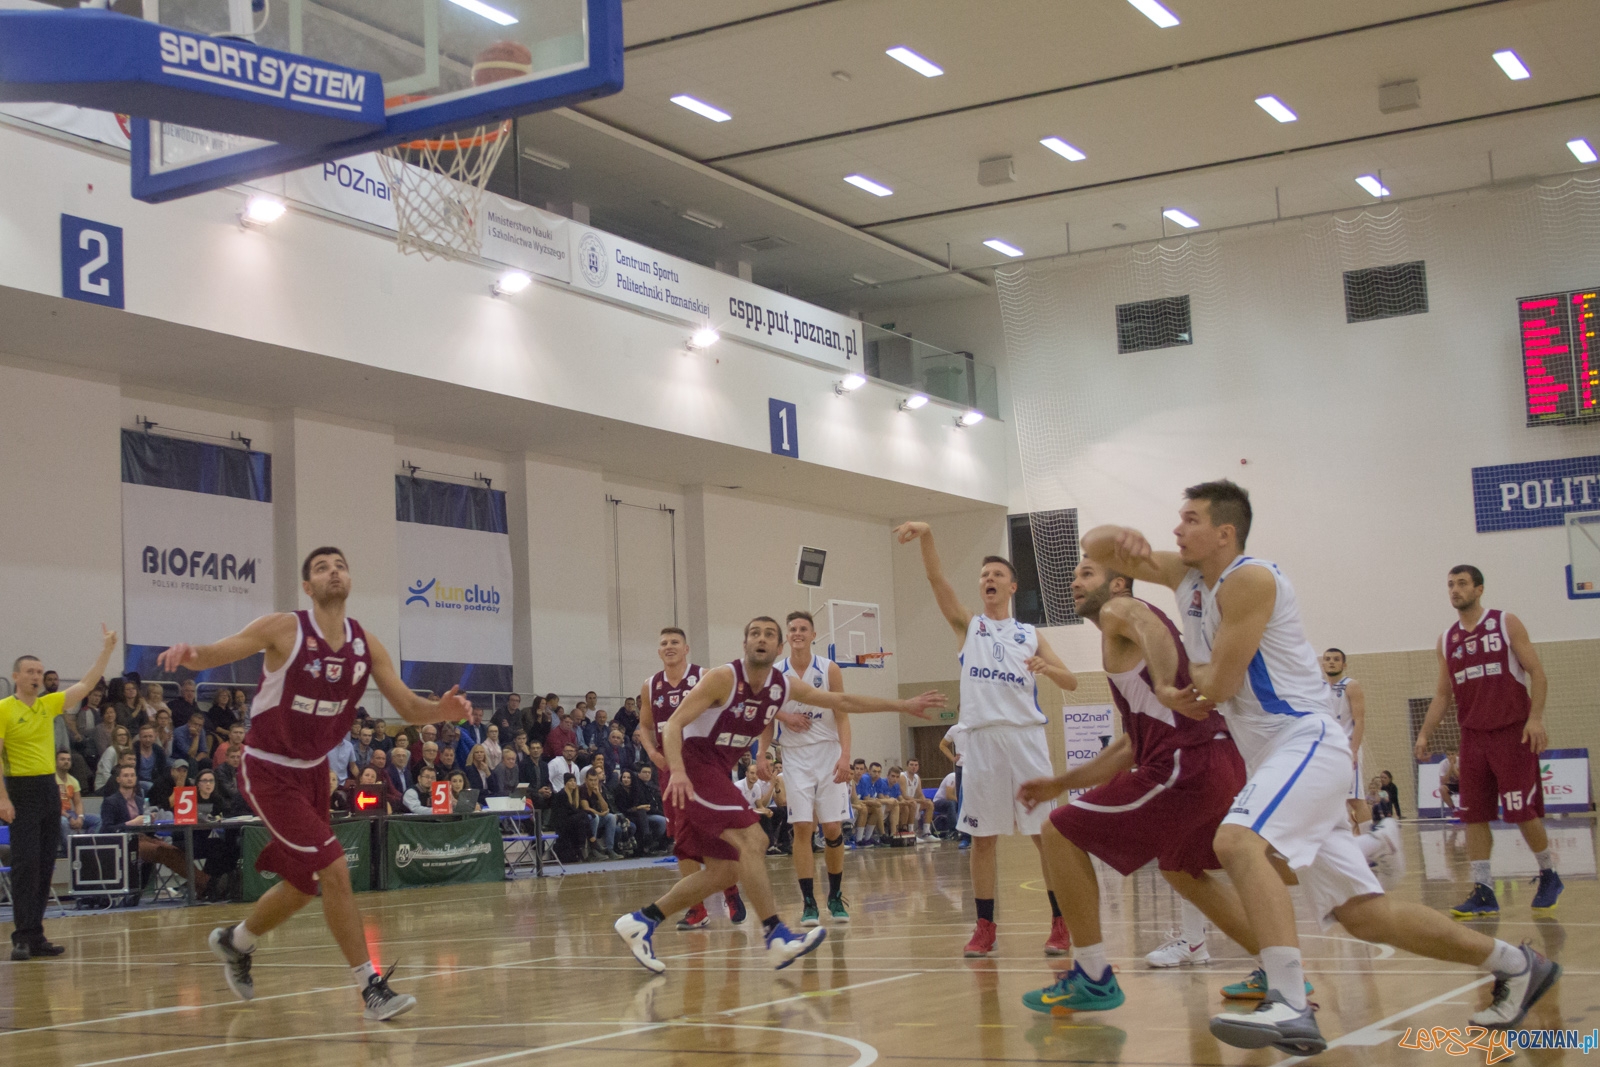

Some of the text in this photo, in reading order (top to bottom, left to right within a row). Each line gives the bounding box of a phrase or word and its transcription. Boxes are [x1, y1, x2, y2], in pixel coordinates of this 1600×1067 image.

[487, 211, 553, 240] Ministerstwo Nauki
[492, 227, 532, 249] Szkolnictwa
[532, 240, 566, 260] Wyższego
[79, 229, 110, 297] 2
[615, 249, 680, 283] Centrum Sportu
[616, 273, 711, 319] Politechniki Poznańskiej
[729, 297, 858, 360] cspp.put.poznan.pl
[779, 407, 790, 451] 1
[1499, 475, 1600, 511] POLIT
[142, 545, 256, 583] BIOFARM
[152, 580, 178, 588] POLSKI
[434, 581, 500, 605] funclub
[435, 601, 500, 614] biuro podróży
[1480, 632, 1502, 653] 15
[970, 667, 1025, 686] BIOFARM
[763, 705, 779, 725] 9
[1067, 750, 1099, 759] POZn
[177, 790, 194, 815] 5
[434, 784, 446, 805] 5
[1503, 791, 1523, 811] 15
